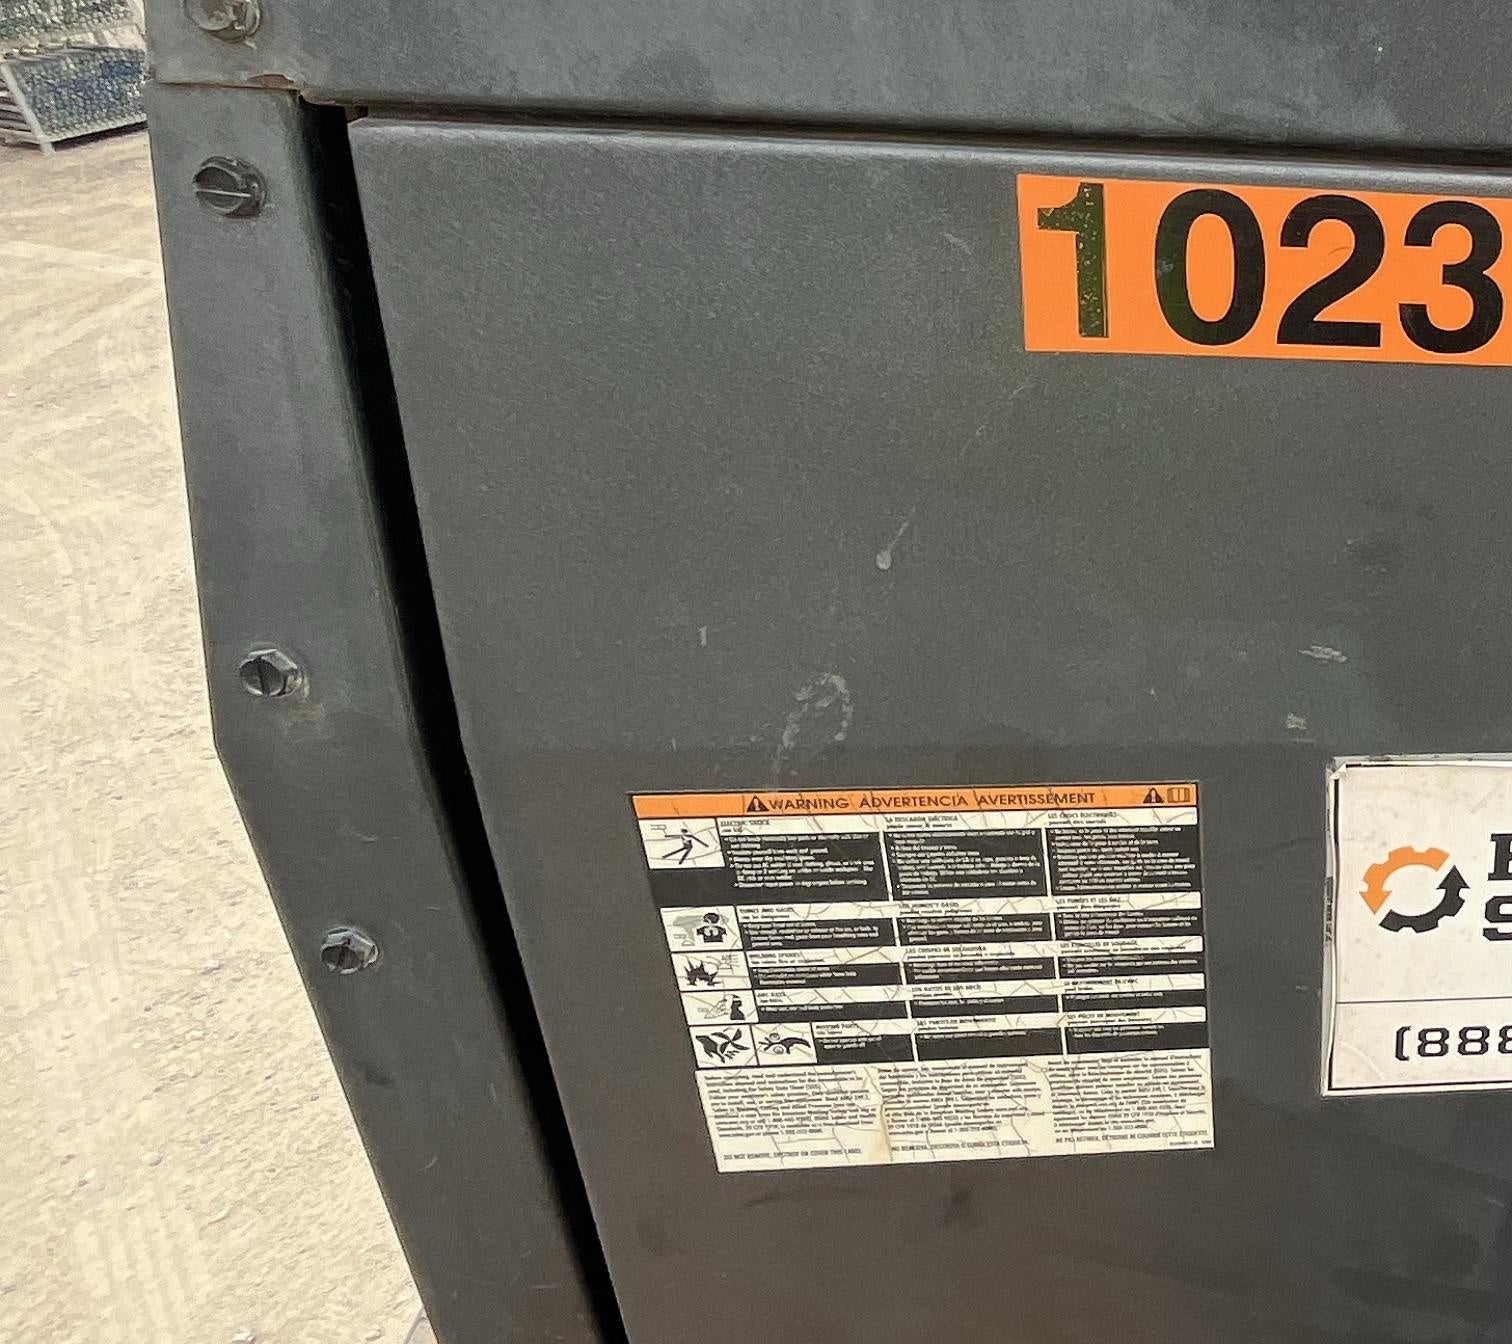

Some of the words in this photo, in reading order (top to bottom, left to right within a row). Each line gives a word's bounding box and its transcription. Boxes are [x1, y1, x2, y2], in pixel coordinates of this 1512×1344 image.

[768, 796, 850, 811] WARNING
[859, 794, 968, 809] ADVERTENCIA
[979, 792, 1095, 807] AVERTISSEMENT
